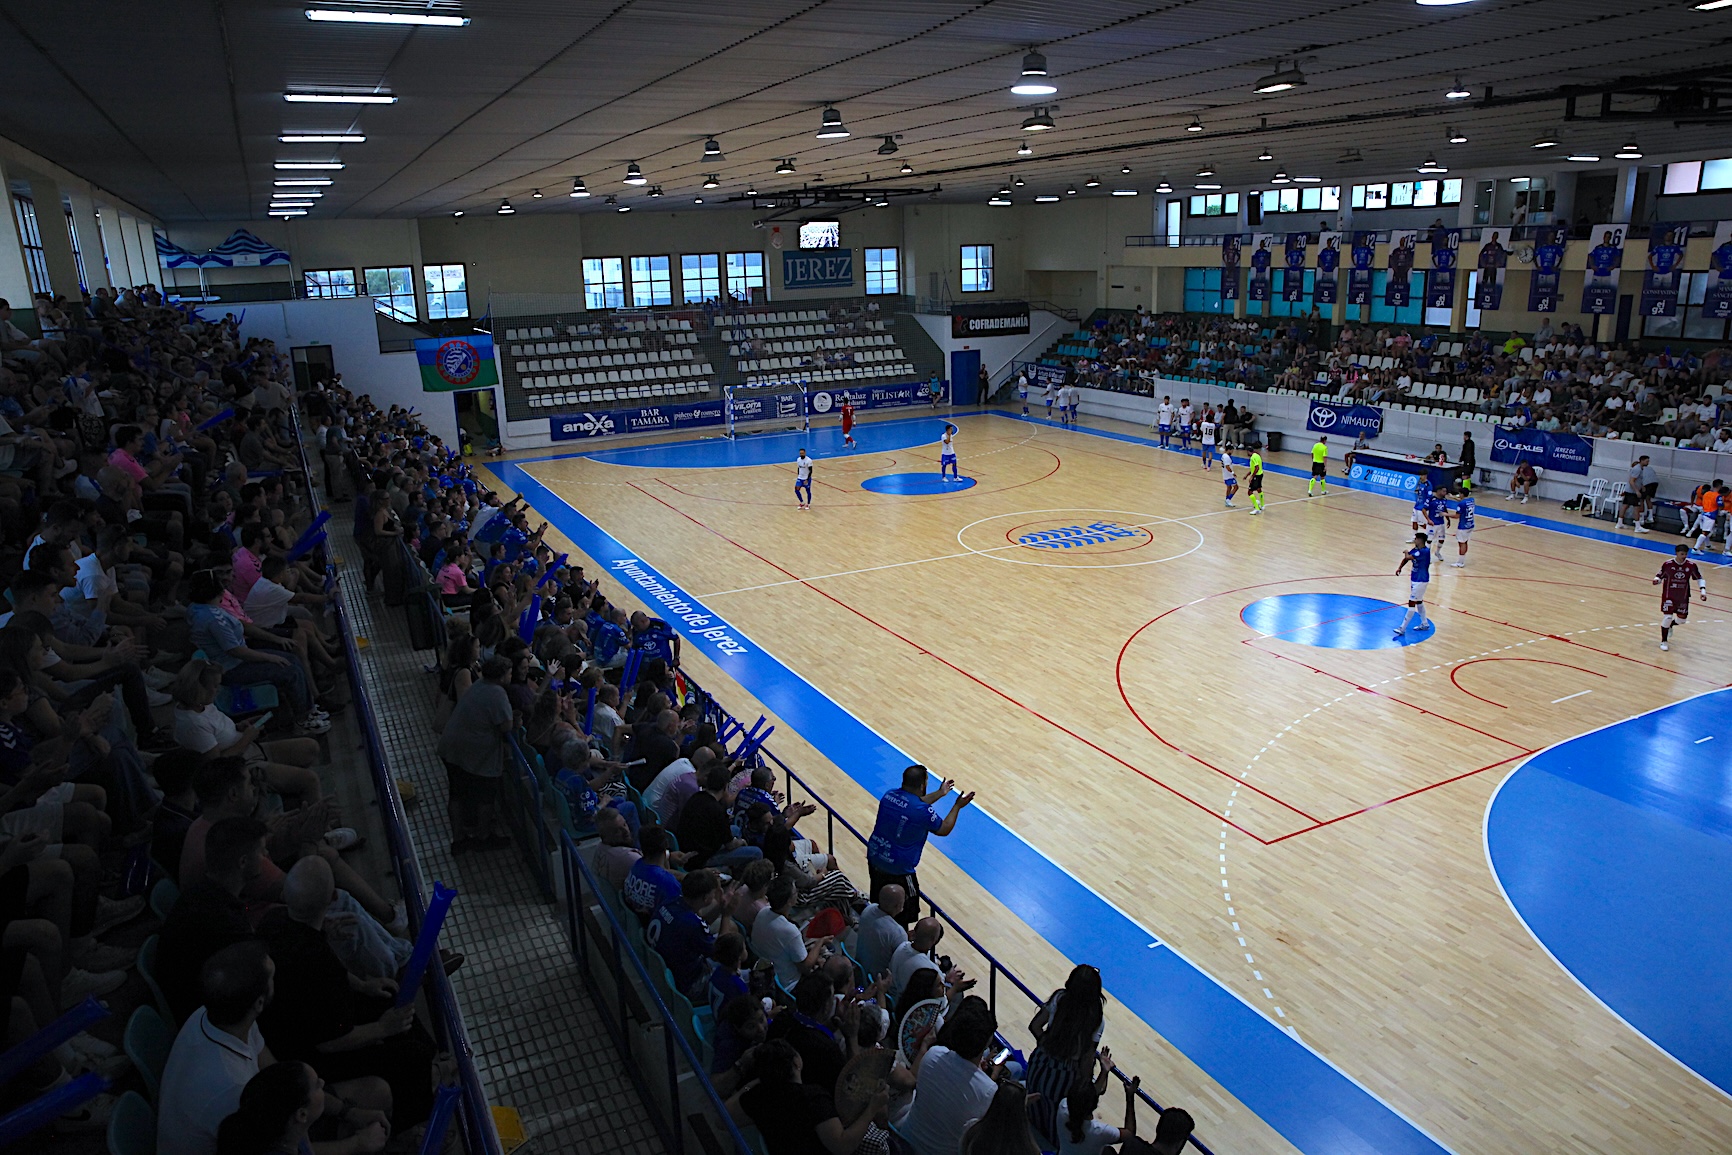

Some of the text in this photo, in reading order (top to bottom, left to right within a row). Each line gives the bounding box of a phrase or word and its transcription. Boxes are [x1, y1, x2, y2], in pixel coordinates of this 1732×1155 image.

[1296, 235, 1307, 249] 20
[1366, 234, 1376, 249] 12
[1447, 232, 1459, 249] 10
[1555, 229, 1565, 244] 5
[1613, 228, 1622, 249] 6
[1674, 226, 1688, 247] 11
[784, 256, 852, 285] JEREZ
[969, 313, 1029, 331] COFRADEMANÍA
[640, 408, 660, 417] BAR
[631, 415, 670, 426] TAMARA
[1340, 415, 1380, 429] NIMAUTO
[1509, 442, 1544, 453] LEXUS
[1559, 453, 1586, 462] FRONTERA
[611, 559, 748, 656] Ayuntamiento de Jerez
